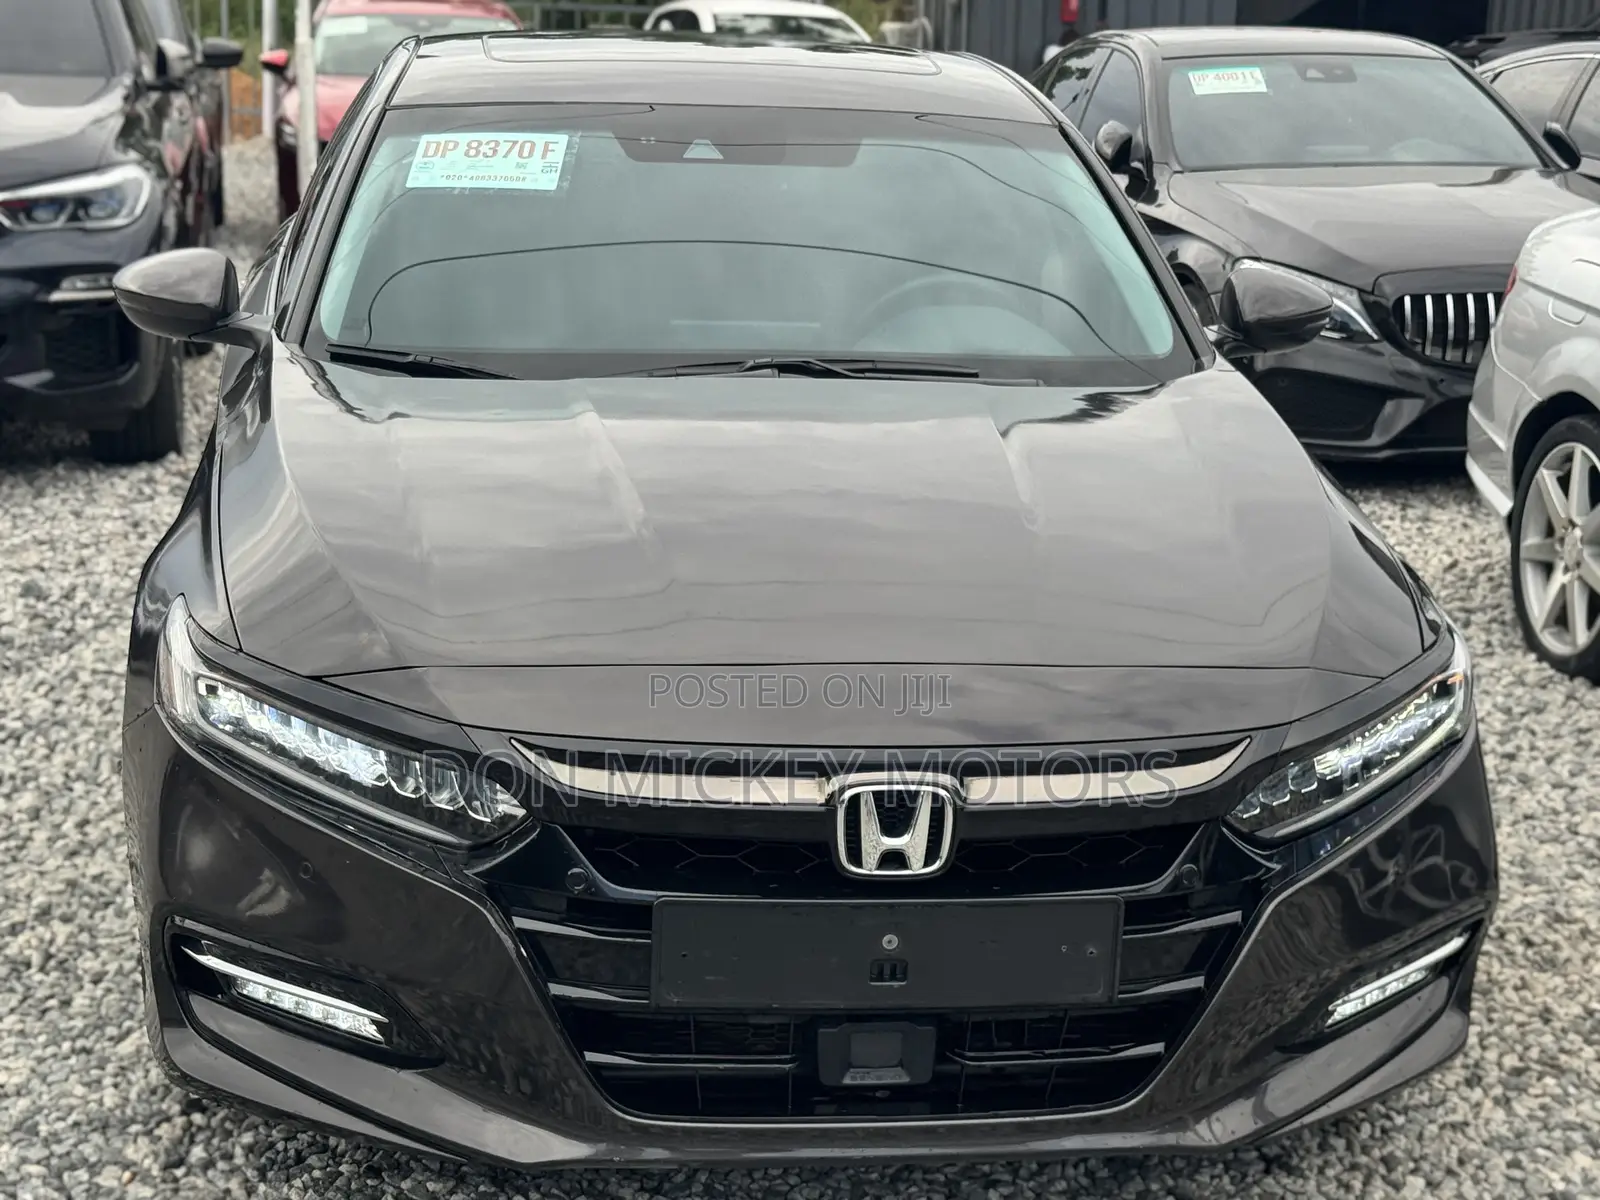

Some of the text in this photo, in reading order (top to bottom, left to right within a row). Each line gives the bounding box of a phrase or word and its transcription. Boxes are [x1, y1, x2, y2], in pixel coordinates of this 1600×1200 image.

[422, 139, 560, 160] DP 8370 F
